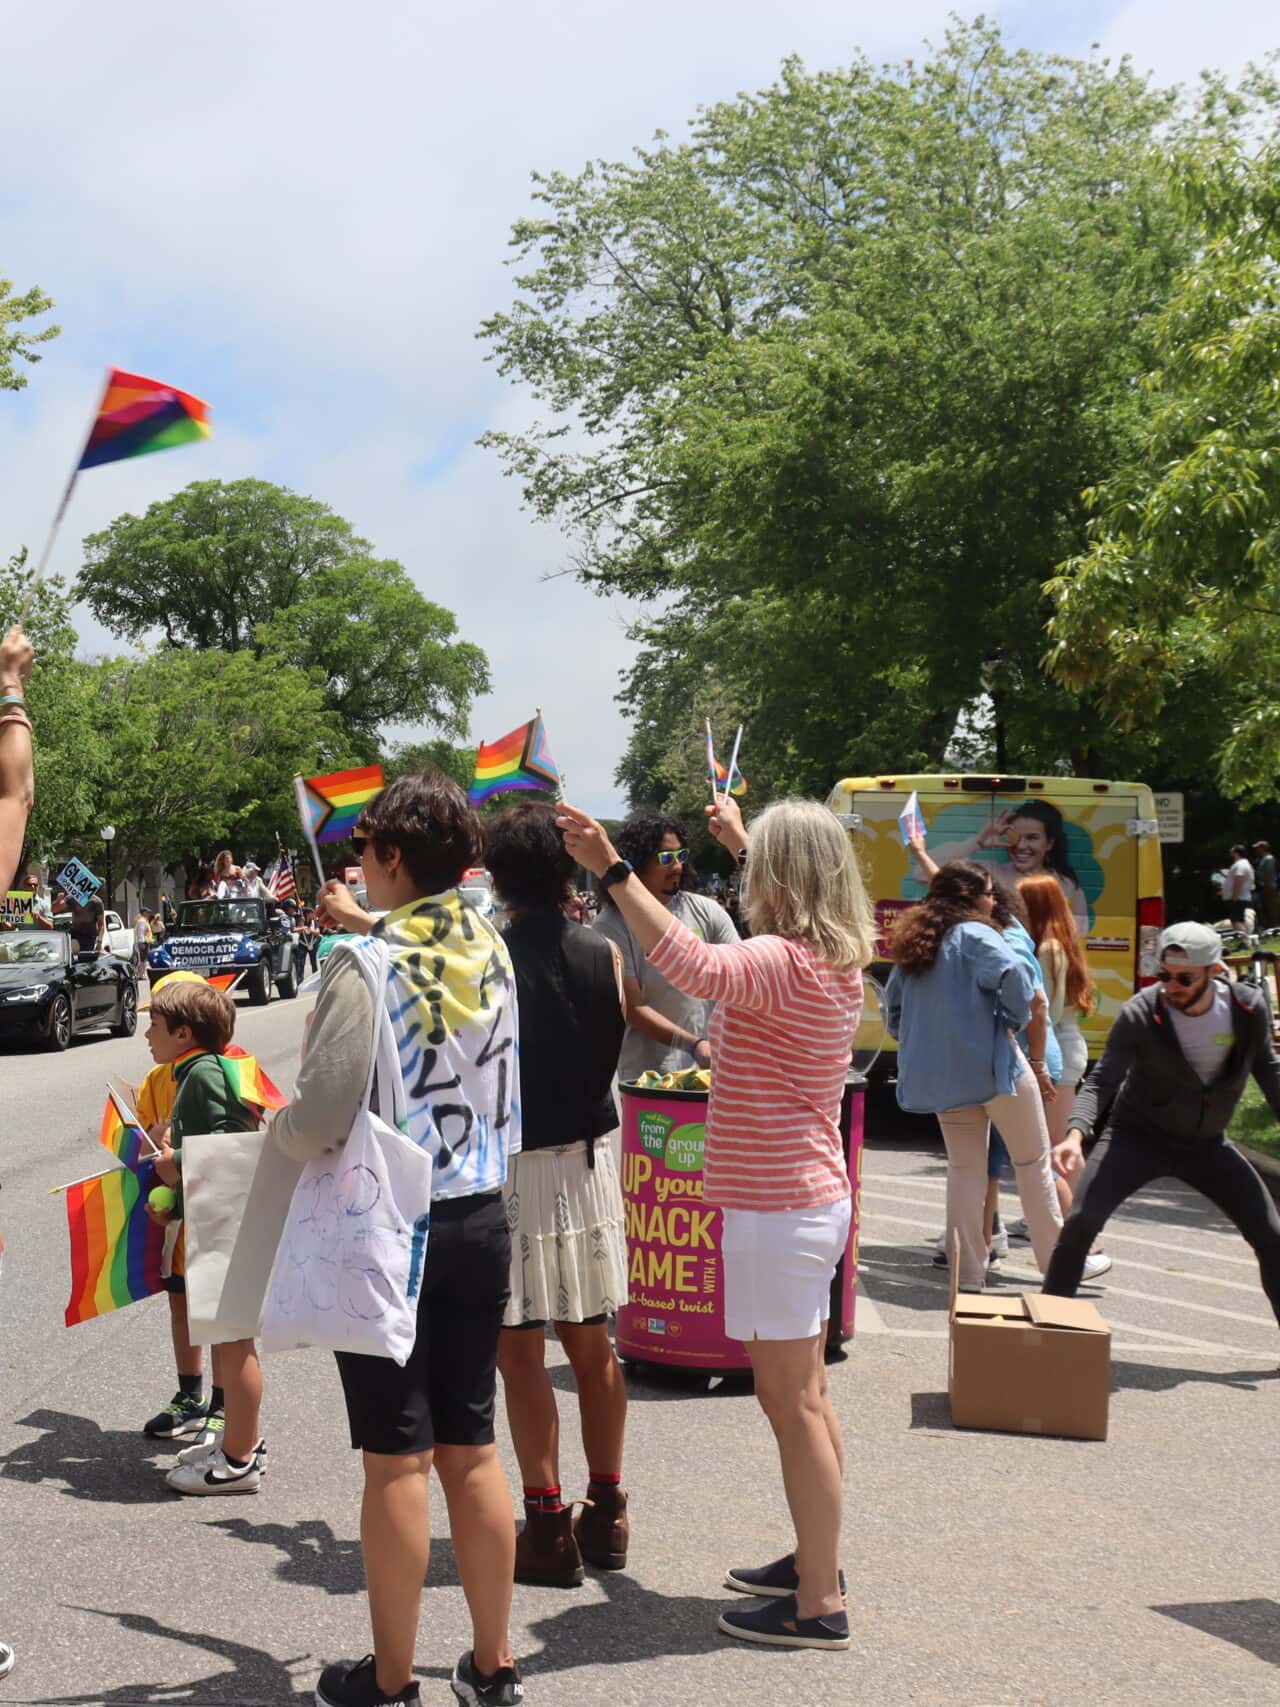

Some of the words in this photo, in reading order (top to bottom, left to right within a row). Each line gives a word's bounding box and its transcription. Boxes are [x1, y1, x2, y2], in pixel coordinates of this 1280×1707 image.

[64, 863, 97, 897] GLAM
[63, 879, 81, 900] PRIDE
[171, 943, 239, 955] DEMOCRATIC
[640, 1121, 665, 1135] from
[643, 1134, 663, 1149] the
[668, 1139, 705, 1154] grou
[678, 1152, 696, 1168] up
[623, 1152, 653, 1195] UP
[655, 1176, 704, 1202] you
[704, 1257, 717, 1265] A
[629, 1247, 698, 1293] AME
[703, 1267, 717, 1294] WITH
[678, 1298, 715, 1314] twist
